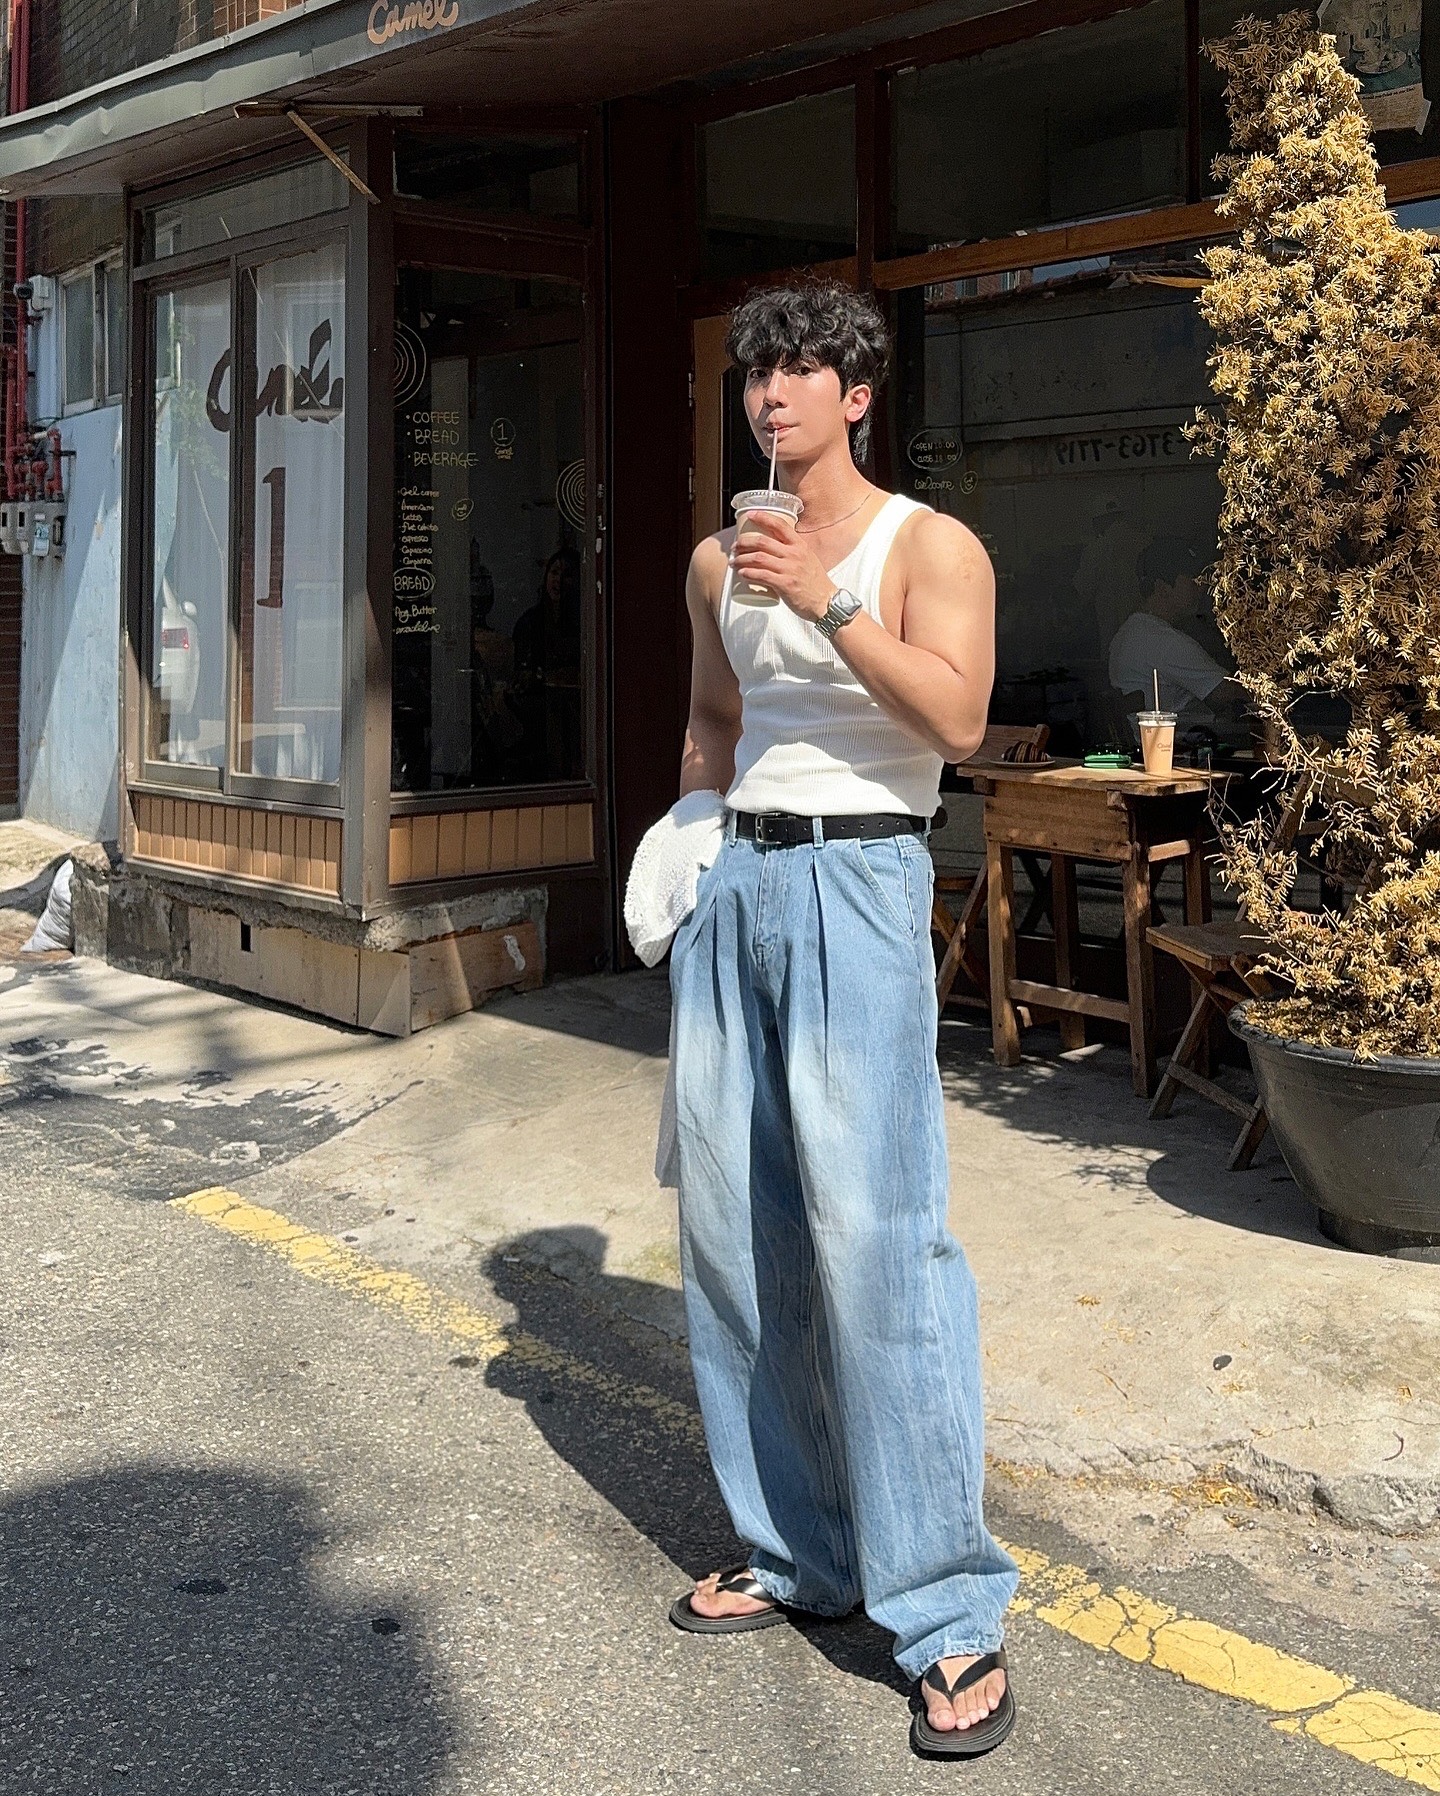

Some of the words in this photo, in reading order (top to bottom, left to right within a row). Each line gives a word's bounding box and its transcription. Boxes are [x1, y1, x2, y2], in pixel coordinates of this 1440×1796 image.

[367, 0, 459, 45] Camel
[412, 411, 460, 425] COFFEE
[414, 428, 460, 446] BREAD
[915, 442, 933, 451] OPEN
[413, 451, 479, 468] BEVERAGE
[393, 575, 431, 592] BREAD
